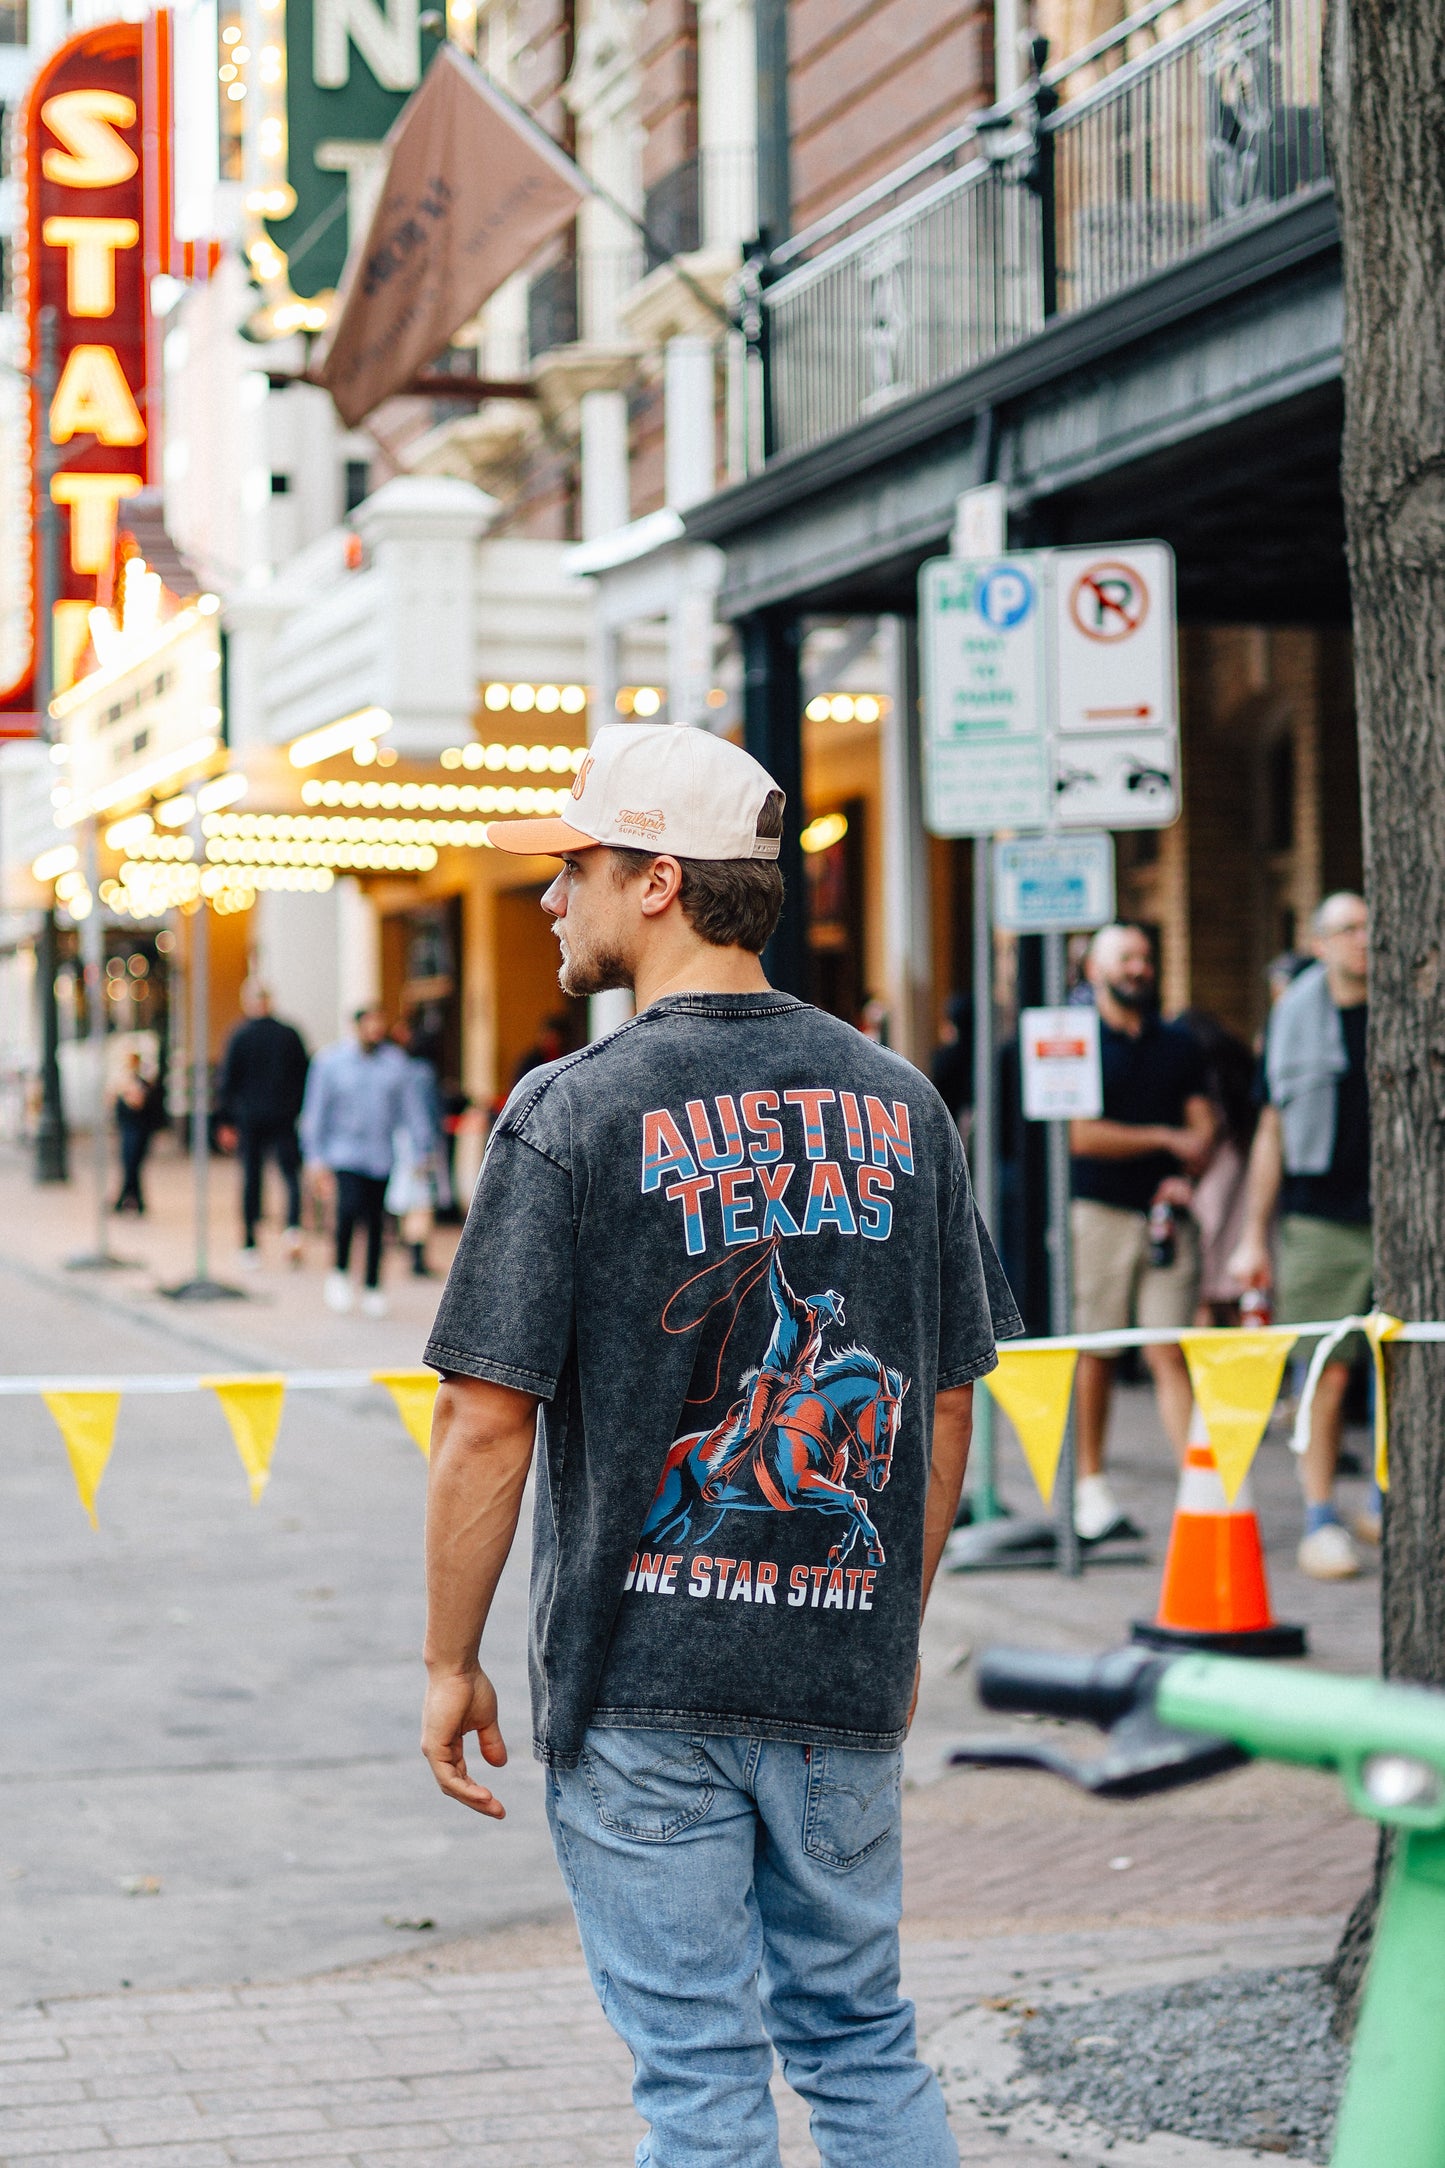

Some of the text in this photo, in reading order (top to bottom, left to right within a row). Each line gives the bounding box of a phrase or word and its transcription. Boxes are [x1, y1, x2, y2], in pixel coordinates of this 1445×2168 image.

[615, 809, 667, 831] Tailspin
[618, 827, 659, 841] SUPPLY CO.
[641, 1089, 914, 1193] AUSTIN
[667, 1161, 895, 1256] TEXAS
[688, 1555, 779, 1605] STAR
[787, 1564, 877, 1611] STATE
